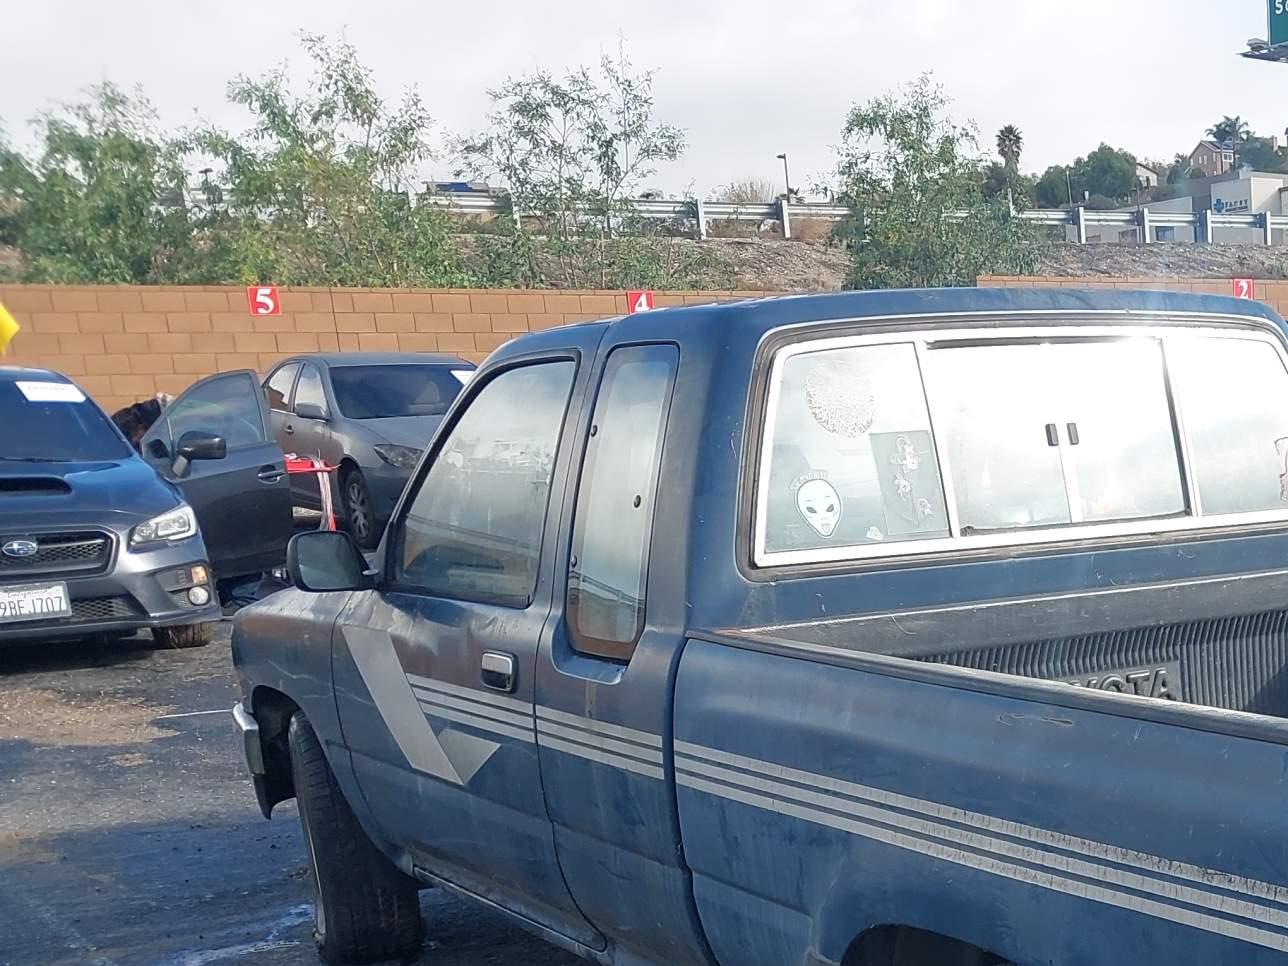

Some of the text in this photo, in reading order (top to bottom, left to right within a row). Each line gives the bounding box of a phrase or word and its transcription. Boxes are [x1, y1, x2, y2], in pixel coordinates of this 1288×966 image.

[1238, 280, 1249, 299] 2
[256, 288, 274, 314] 5
[634, 292, 651, 311] 4
